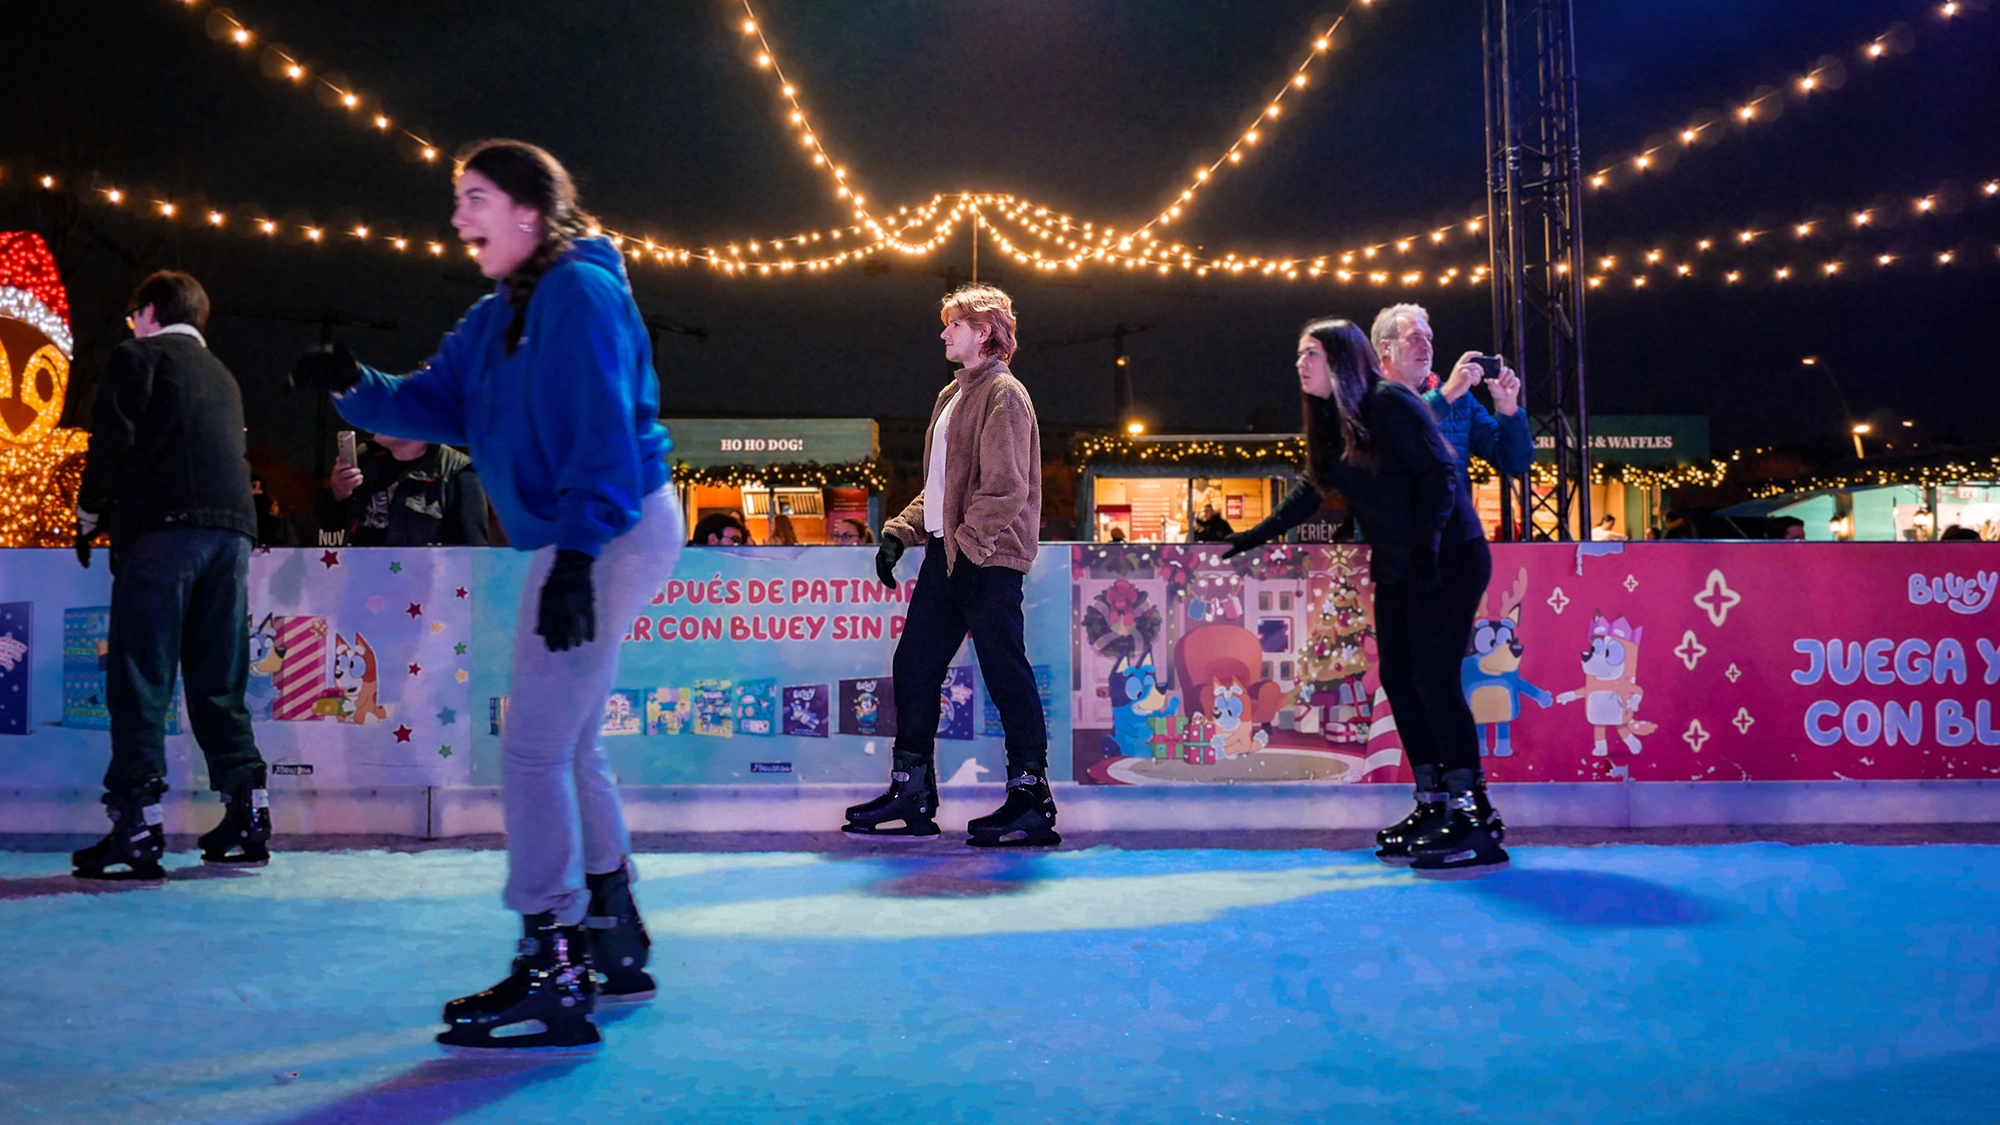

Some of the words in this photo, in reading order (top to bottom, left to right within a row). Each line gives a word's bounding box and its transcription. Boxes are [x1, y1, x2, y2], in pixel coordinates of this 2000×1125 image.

[721, 439, 742, 451] HO
[744, 439, 765, 451] HO
[768, 439, 803, 451] DOG!
[1595, 436, 1606, 449] &
[1607, 436, 1673, 449] WAFFLES
[748, 579, 785, 604] DE
[1908, 570, 1998, 614] BLUEY
[657, 616, 723, 641] CON
[729, 616, 826, 641] BLUEY
[831, 615, 882, 640] SIN
[1791, 638, 1967, 685] JUEGA
[1804, 699, 1923, 746] CON
